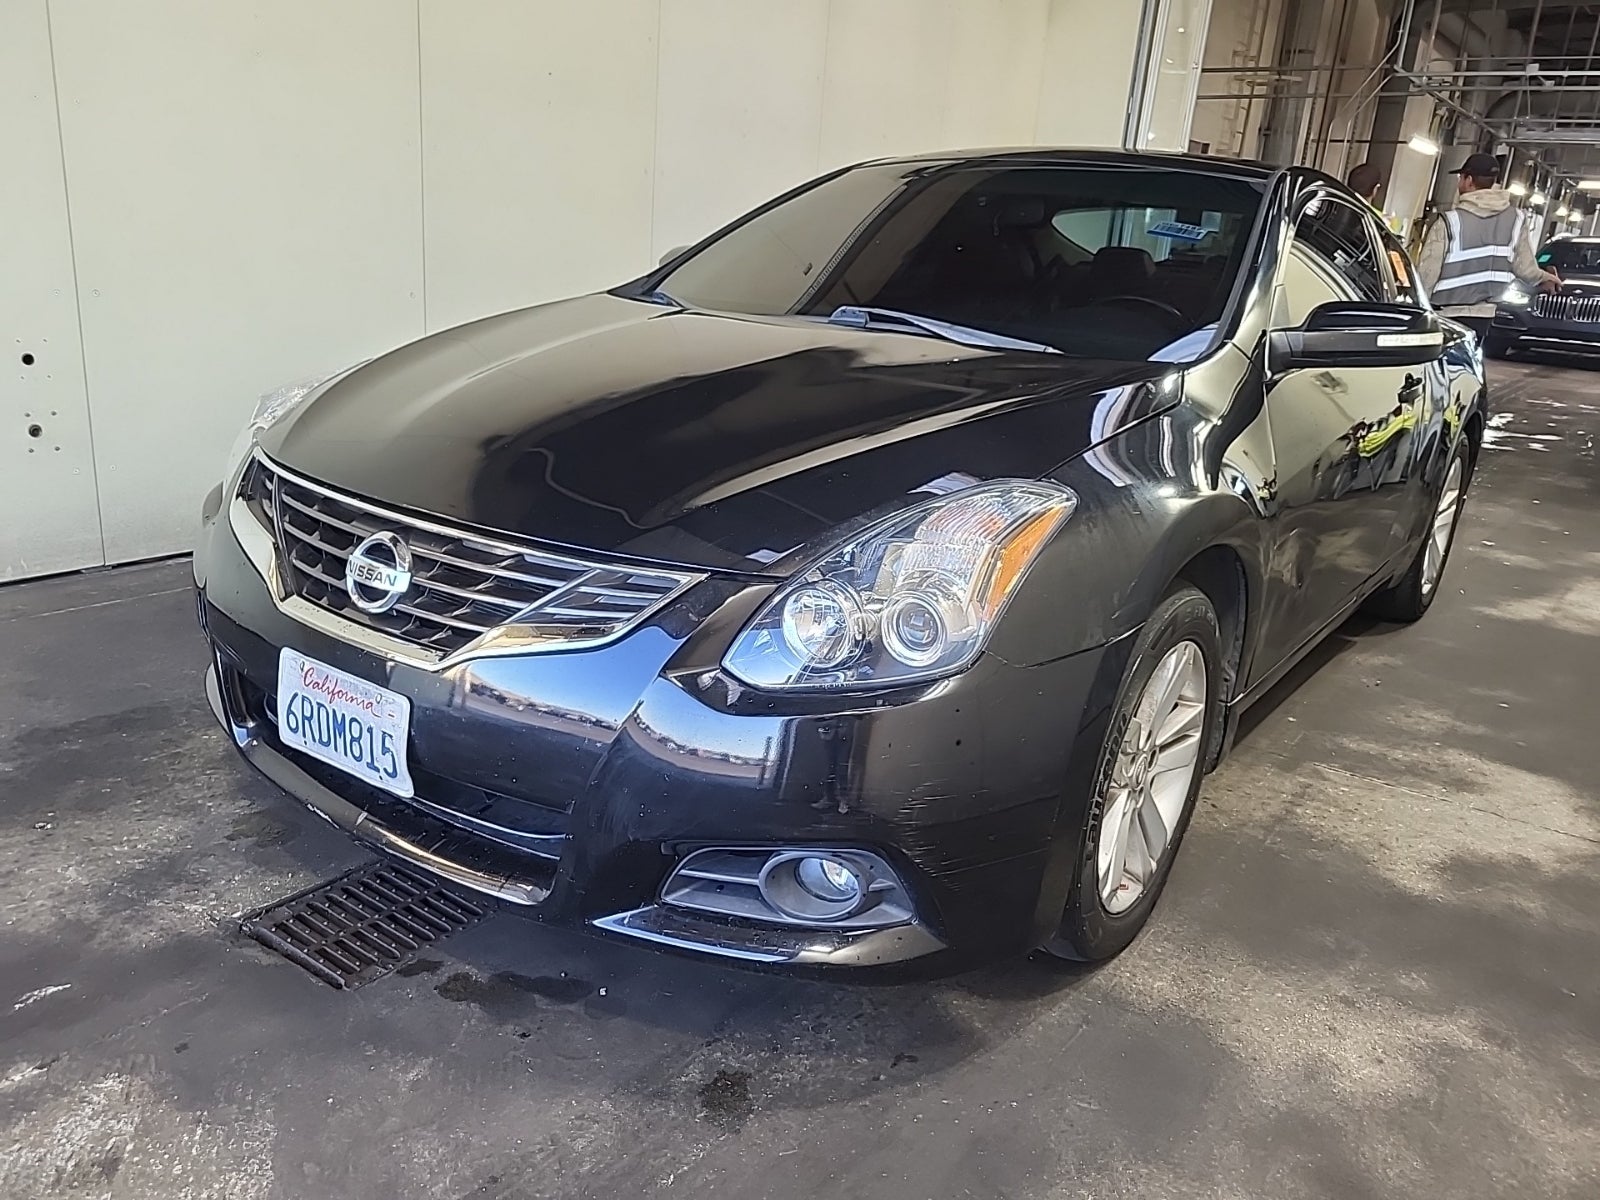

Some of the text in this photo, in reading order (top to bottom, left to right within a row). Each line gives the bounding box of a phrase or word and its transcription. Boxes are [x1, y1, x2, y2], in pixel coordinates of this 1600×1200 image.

[349, 560, 397, 586] NISSAN
[303, 667, 381, 718] California
[286, 692, 398, 779] 6RDM815
